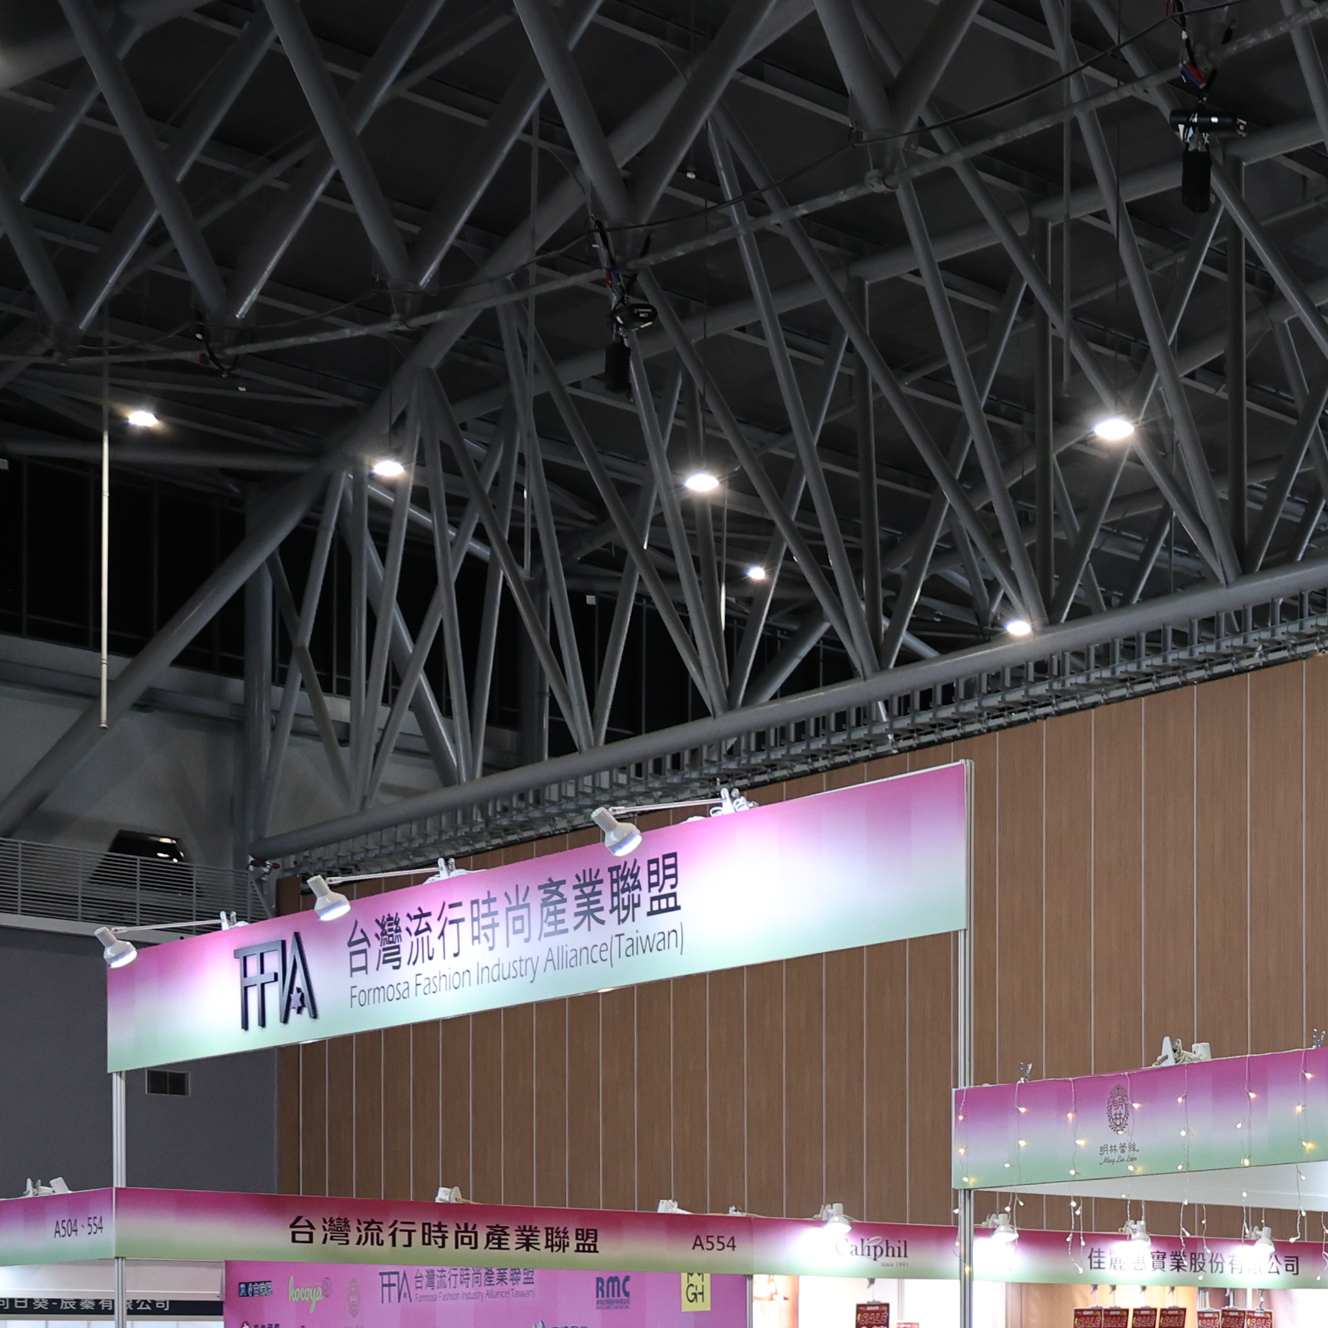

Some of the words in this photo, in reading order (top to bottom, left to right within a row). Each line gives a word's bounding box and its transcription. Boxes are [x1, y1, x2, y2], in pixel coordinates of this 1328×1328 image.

[346, 851, 682, 978] 台灣流行時尚產業聯盟
[349, 979, 410, 1009] Formosa
[414, 968, 471, 998] Fashion
[477, 953, 539, 987] Industry
[288, 1215, 600, 1254] 台灣流行時尚產業聯盟
[691, 1234, 737, 1252] A554
[834, 1235, 909, 1262] Caliphil
[414, 1267, 535, 1291] 台灣流行時尚產業聯盟
[595, 1275, 631, 1299] RMC
